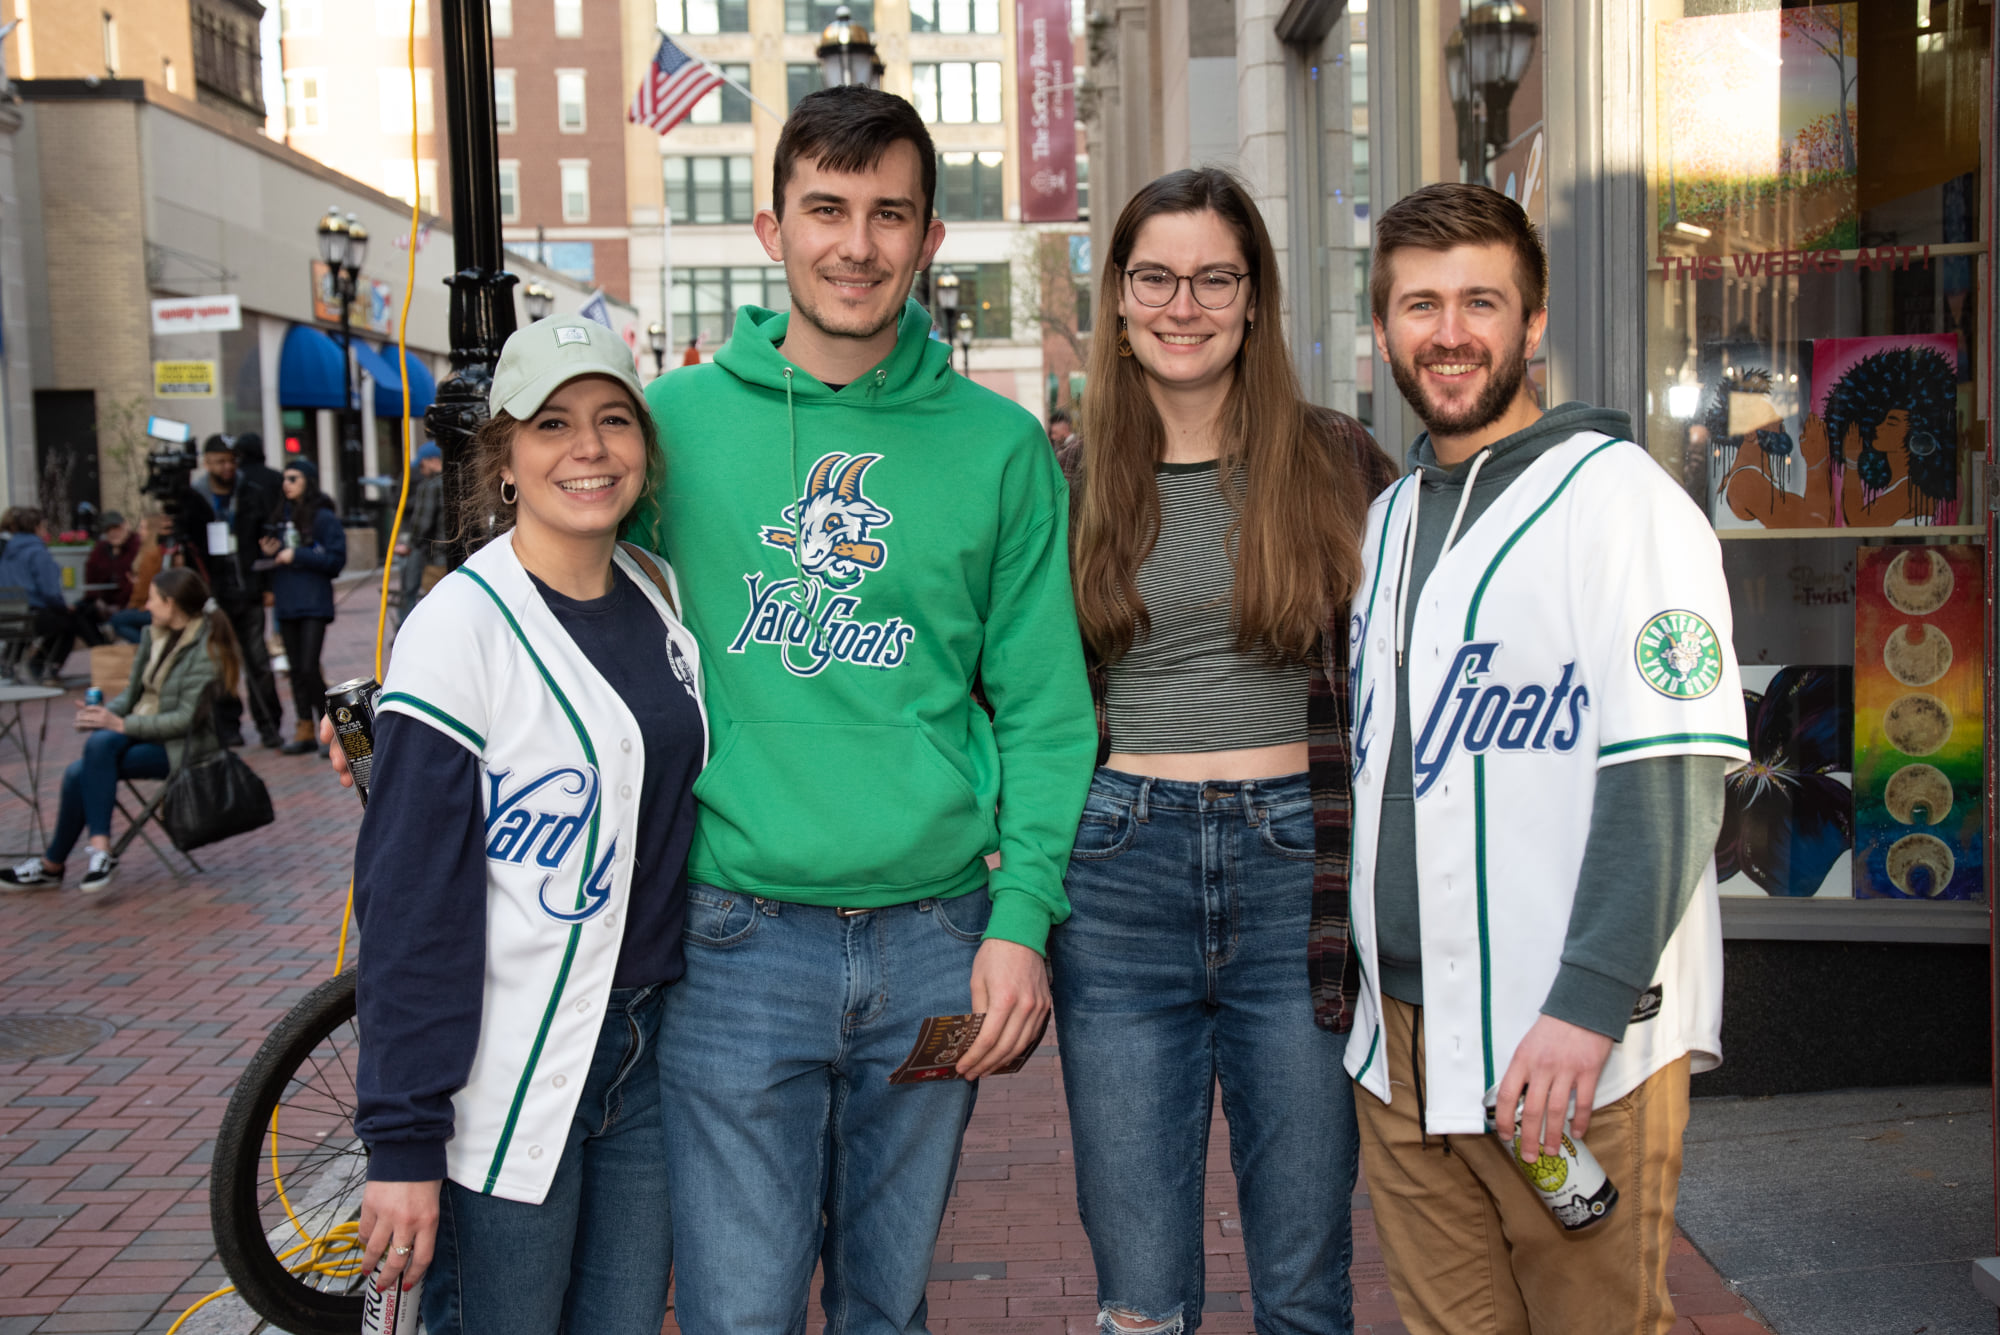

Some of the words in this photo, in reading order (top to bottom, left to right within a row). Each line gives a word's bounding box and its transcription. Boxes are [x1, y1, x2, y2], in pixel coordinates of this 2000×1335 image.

[1030, 18, 1048, 67] Room
[1031, 68, 1053, 128] Soty
[1032, 128, 1049, 162] The
[1656, 256, 1723, 281] THIS
[1733, 249, 1844, 277] WEEKS
[1802, 587, 1849, 606] Twist
[727, 571, 820, 654] Yard
[781, 594, 915, 678] Goats
[1642, 615, 1714, 648] HARTFORD
[1643, 657, 1679, 693] YARD
[1684, 657, 1719, 695] GOATS
[1415, 640, 1590, 800] Goats
[485, 763, 600, 871] Yard
[364, 1266, 383, 1332] TRU
[384, 1293, 396, 1335] RASPBERRY
